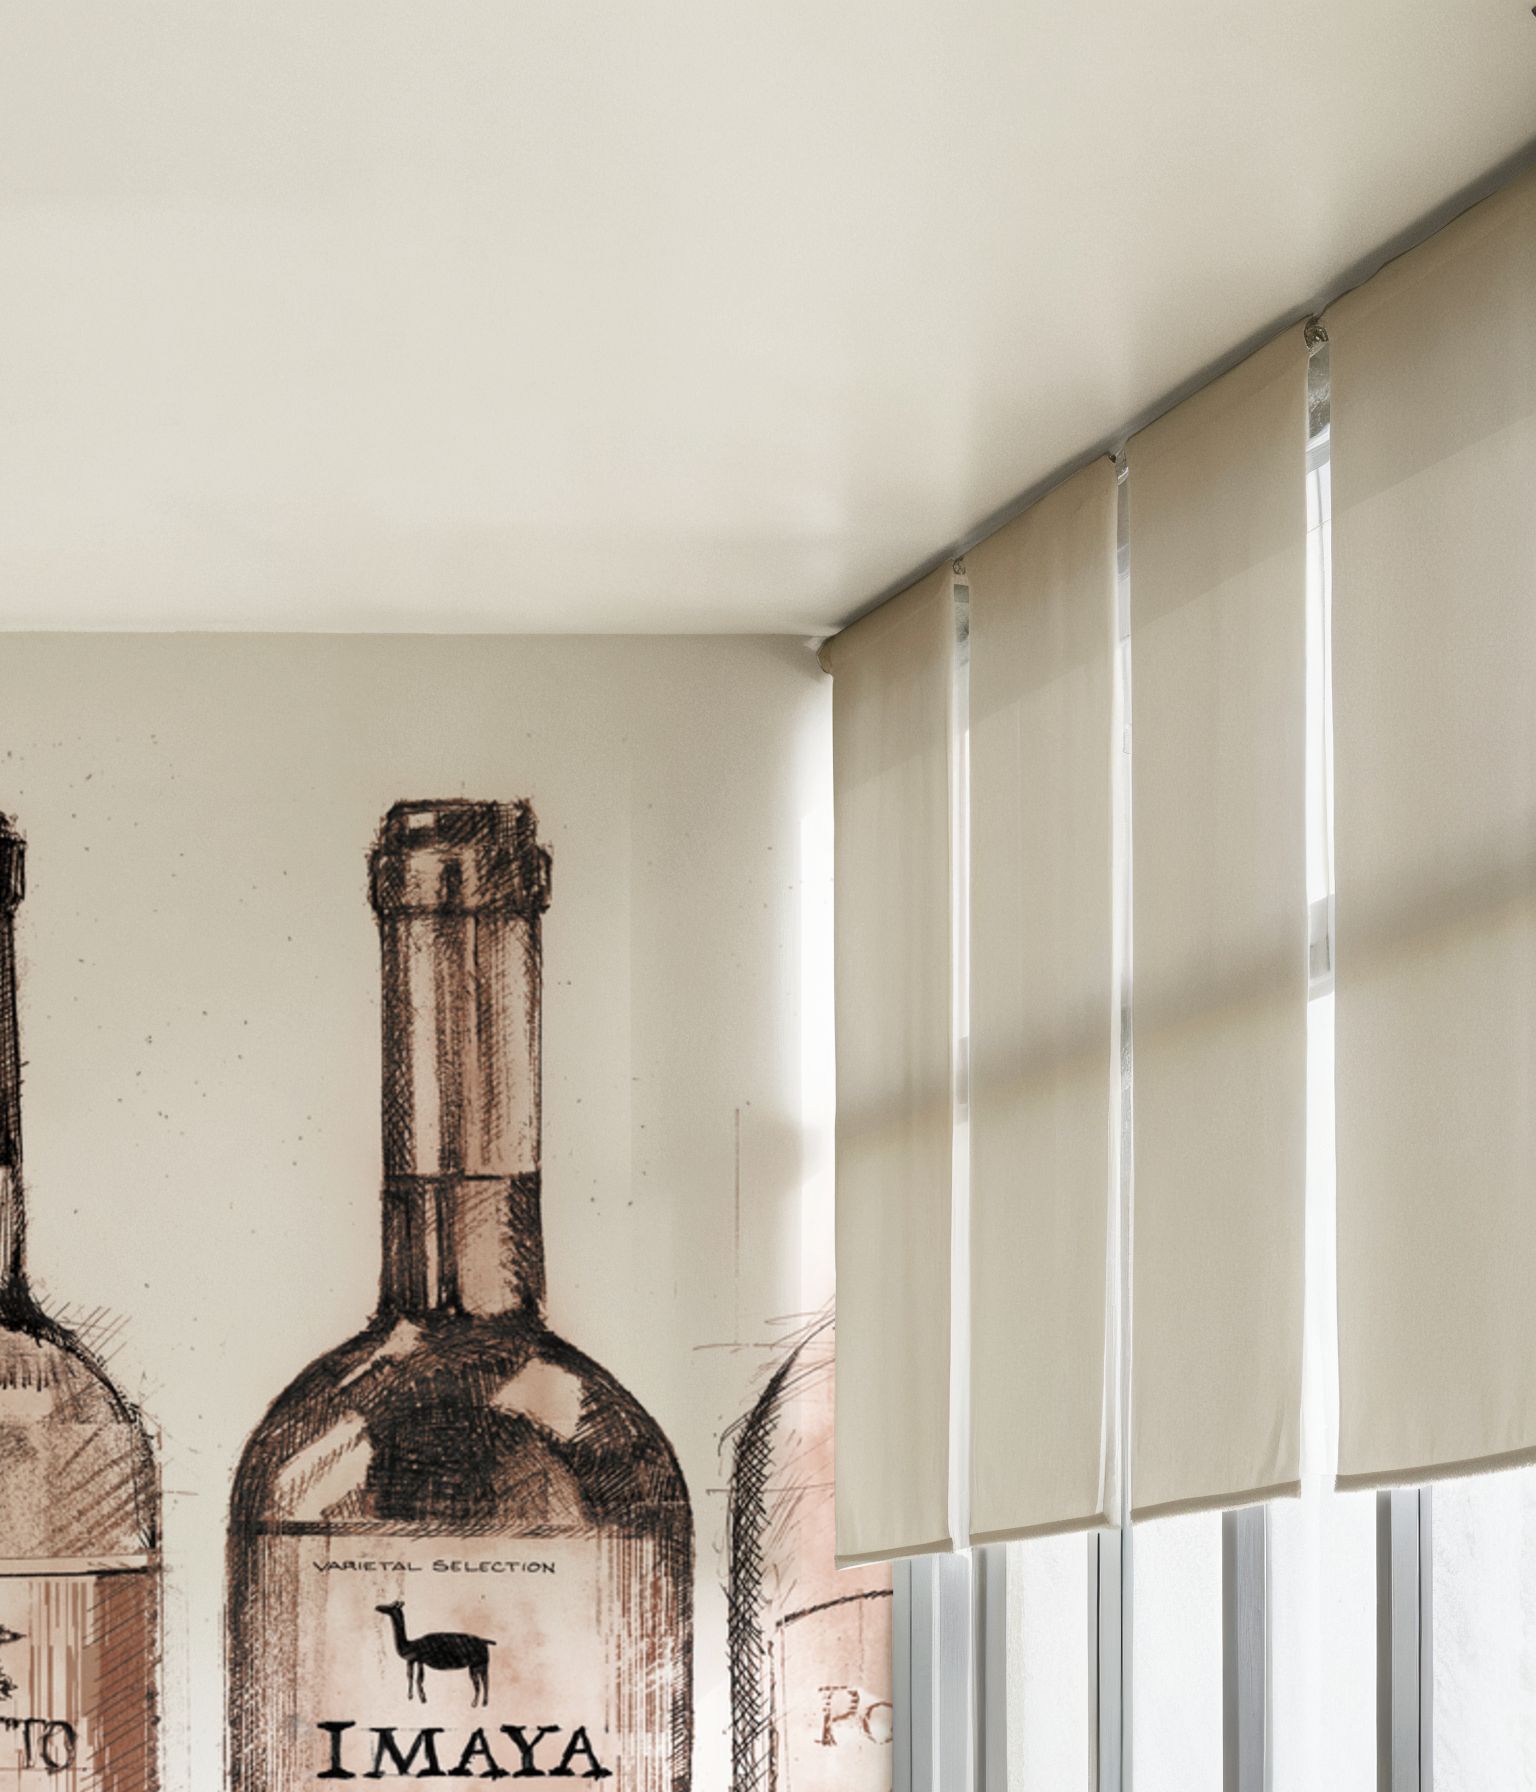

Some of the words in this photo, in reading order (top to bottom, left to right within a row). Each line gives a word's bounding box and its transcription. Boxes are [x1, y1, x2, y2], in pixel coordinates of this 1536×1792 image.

[312, 1559, 422, 1573] VARIETAL
[432, 1559, 556, 1574] SELECTION
[316, 1720, 613, 1781] IMAYA
